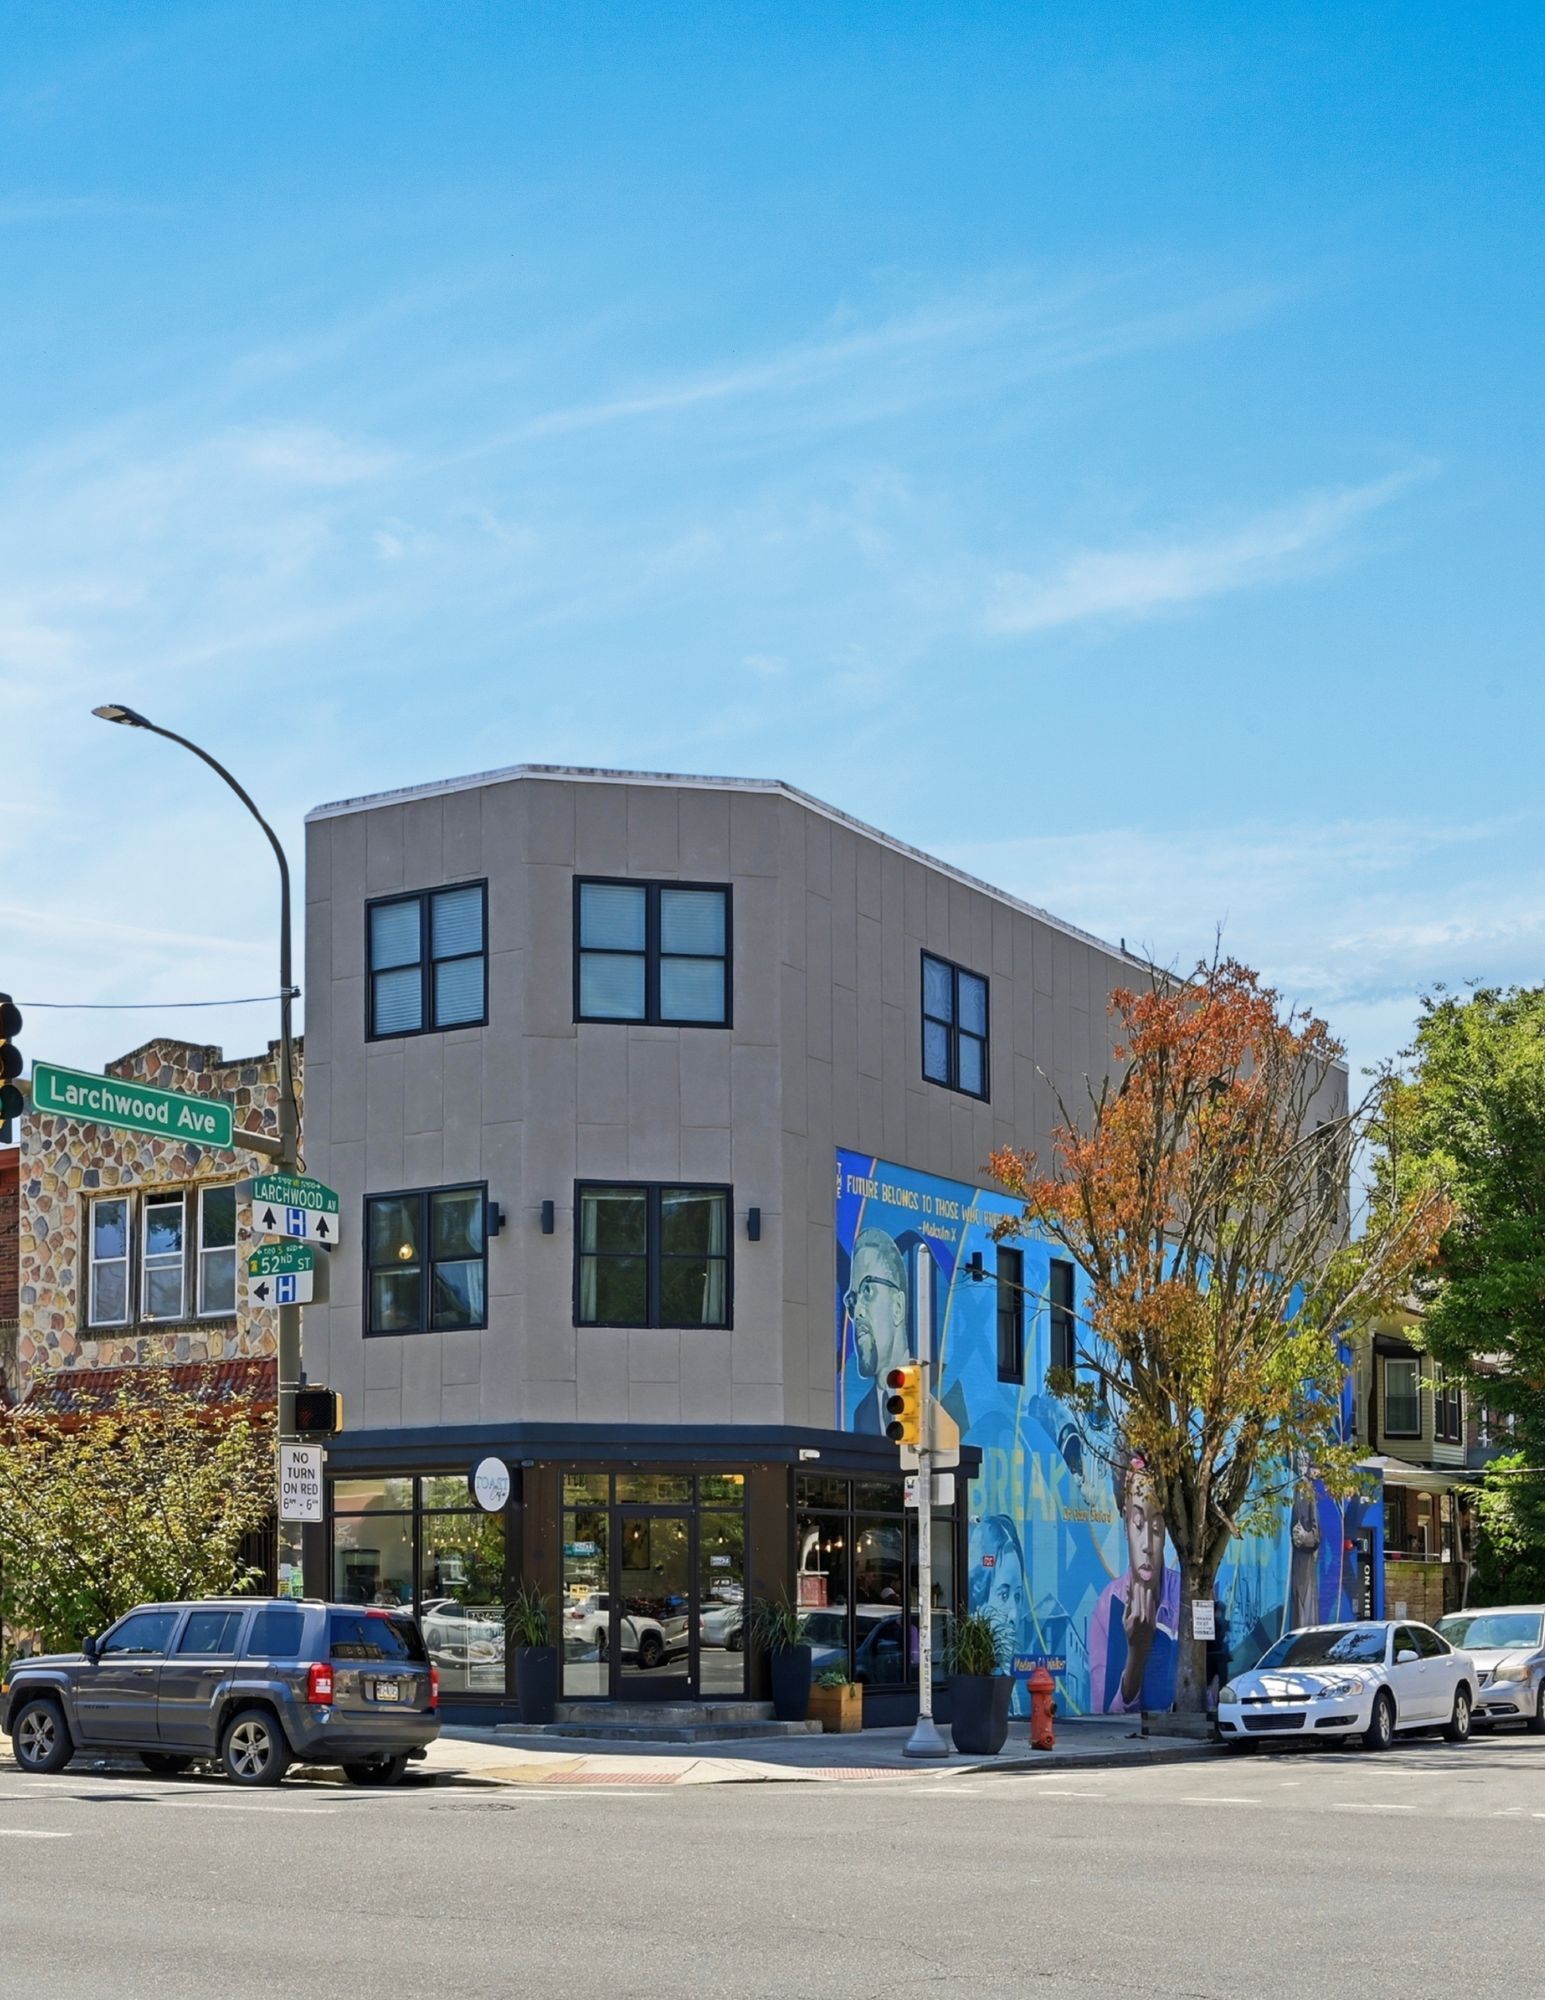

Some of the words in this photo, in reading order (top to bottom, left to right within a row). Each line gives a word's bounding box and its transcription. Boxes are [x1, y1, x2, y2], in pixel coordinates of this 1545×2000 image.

[50, 1075, 169, 1124] Larchwood
[177, 1105, 216, 1134] Ave
[254, 1181, 324, 1210] LARCHWOOD
[327, 1200, 337, 1211] AV
[846, 1174, 879, 1200] FUTURE
[882, 1183, 919, 1211] BELONGS
[922, 1194, 932, 1214] TO
[935, 1197, 959, 1221] THOSE
[297, 1257, 311, 1270] ST
[292, 1452, 309, 1464] NO
[287, 1467, 316, 1479] TURN
[283, 1482, 298, 1494] ON
[300, 1483, 319, 1495] RED
[476, 1475, 508, 1490] TOAST
[1363, 1564, 1371, 1586] ON
[1363, 1591, 1371, 1617] THE
